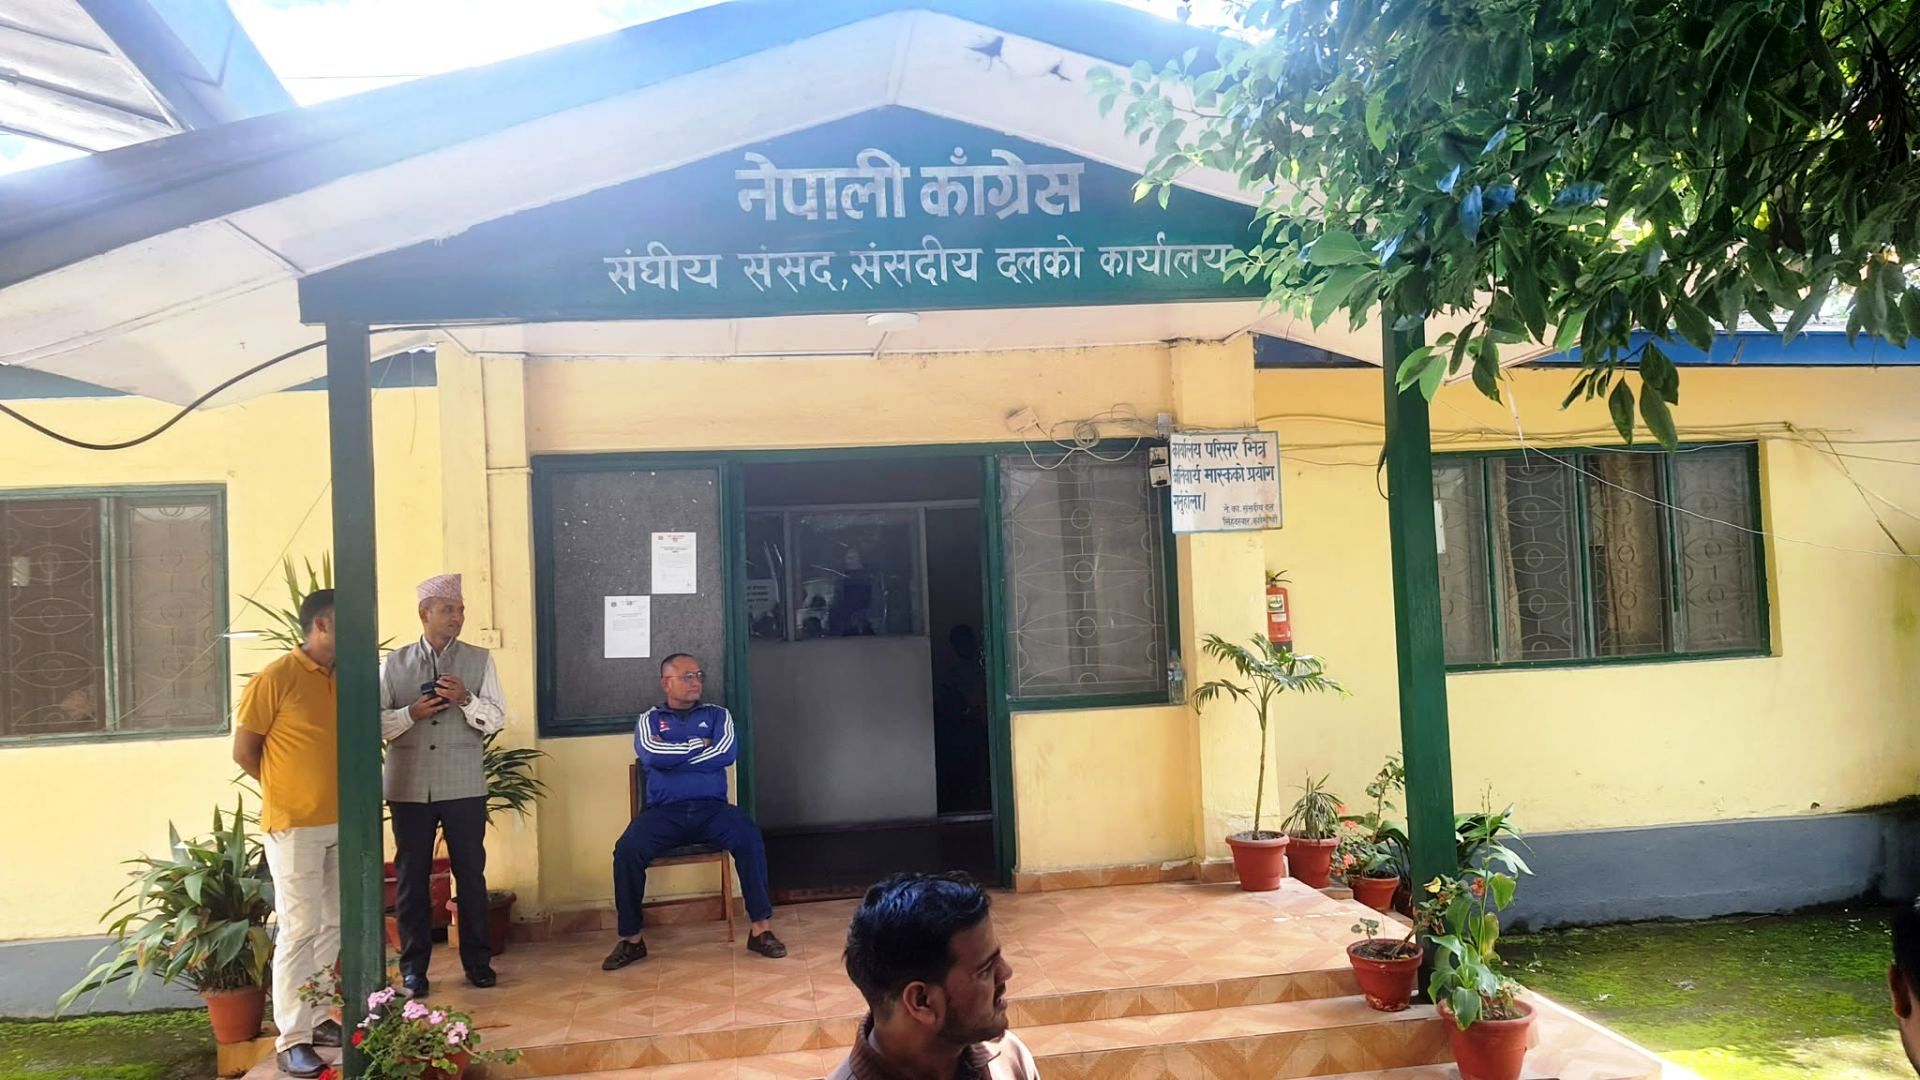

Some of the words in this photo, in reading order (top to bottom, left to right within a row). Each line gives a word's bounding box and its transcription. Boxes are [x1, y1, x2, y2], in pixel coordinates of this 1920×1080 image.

[735, 148, 911, 220] नेपाली
[920, 146, 1085, 220] काँग्रेस
[603, 241, 722, 294] संघीय
[995, 235, 1084, 284] दलको
[1098, 231, 1234, 279] कार्यालय
[1204, 438, 1239, 461] परिसर
[1242, 437, 1267, 458] भित्र
[1204, 463, 1245, 487] मास्कको
[1246, 462, 1275, 482] प्रयोग
